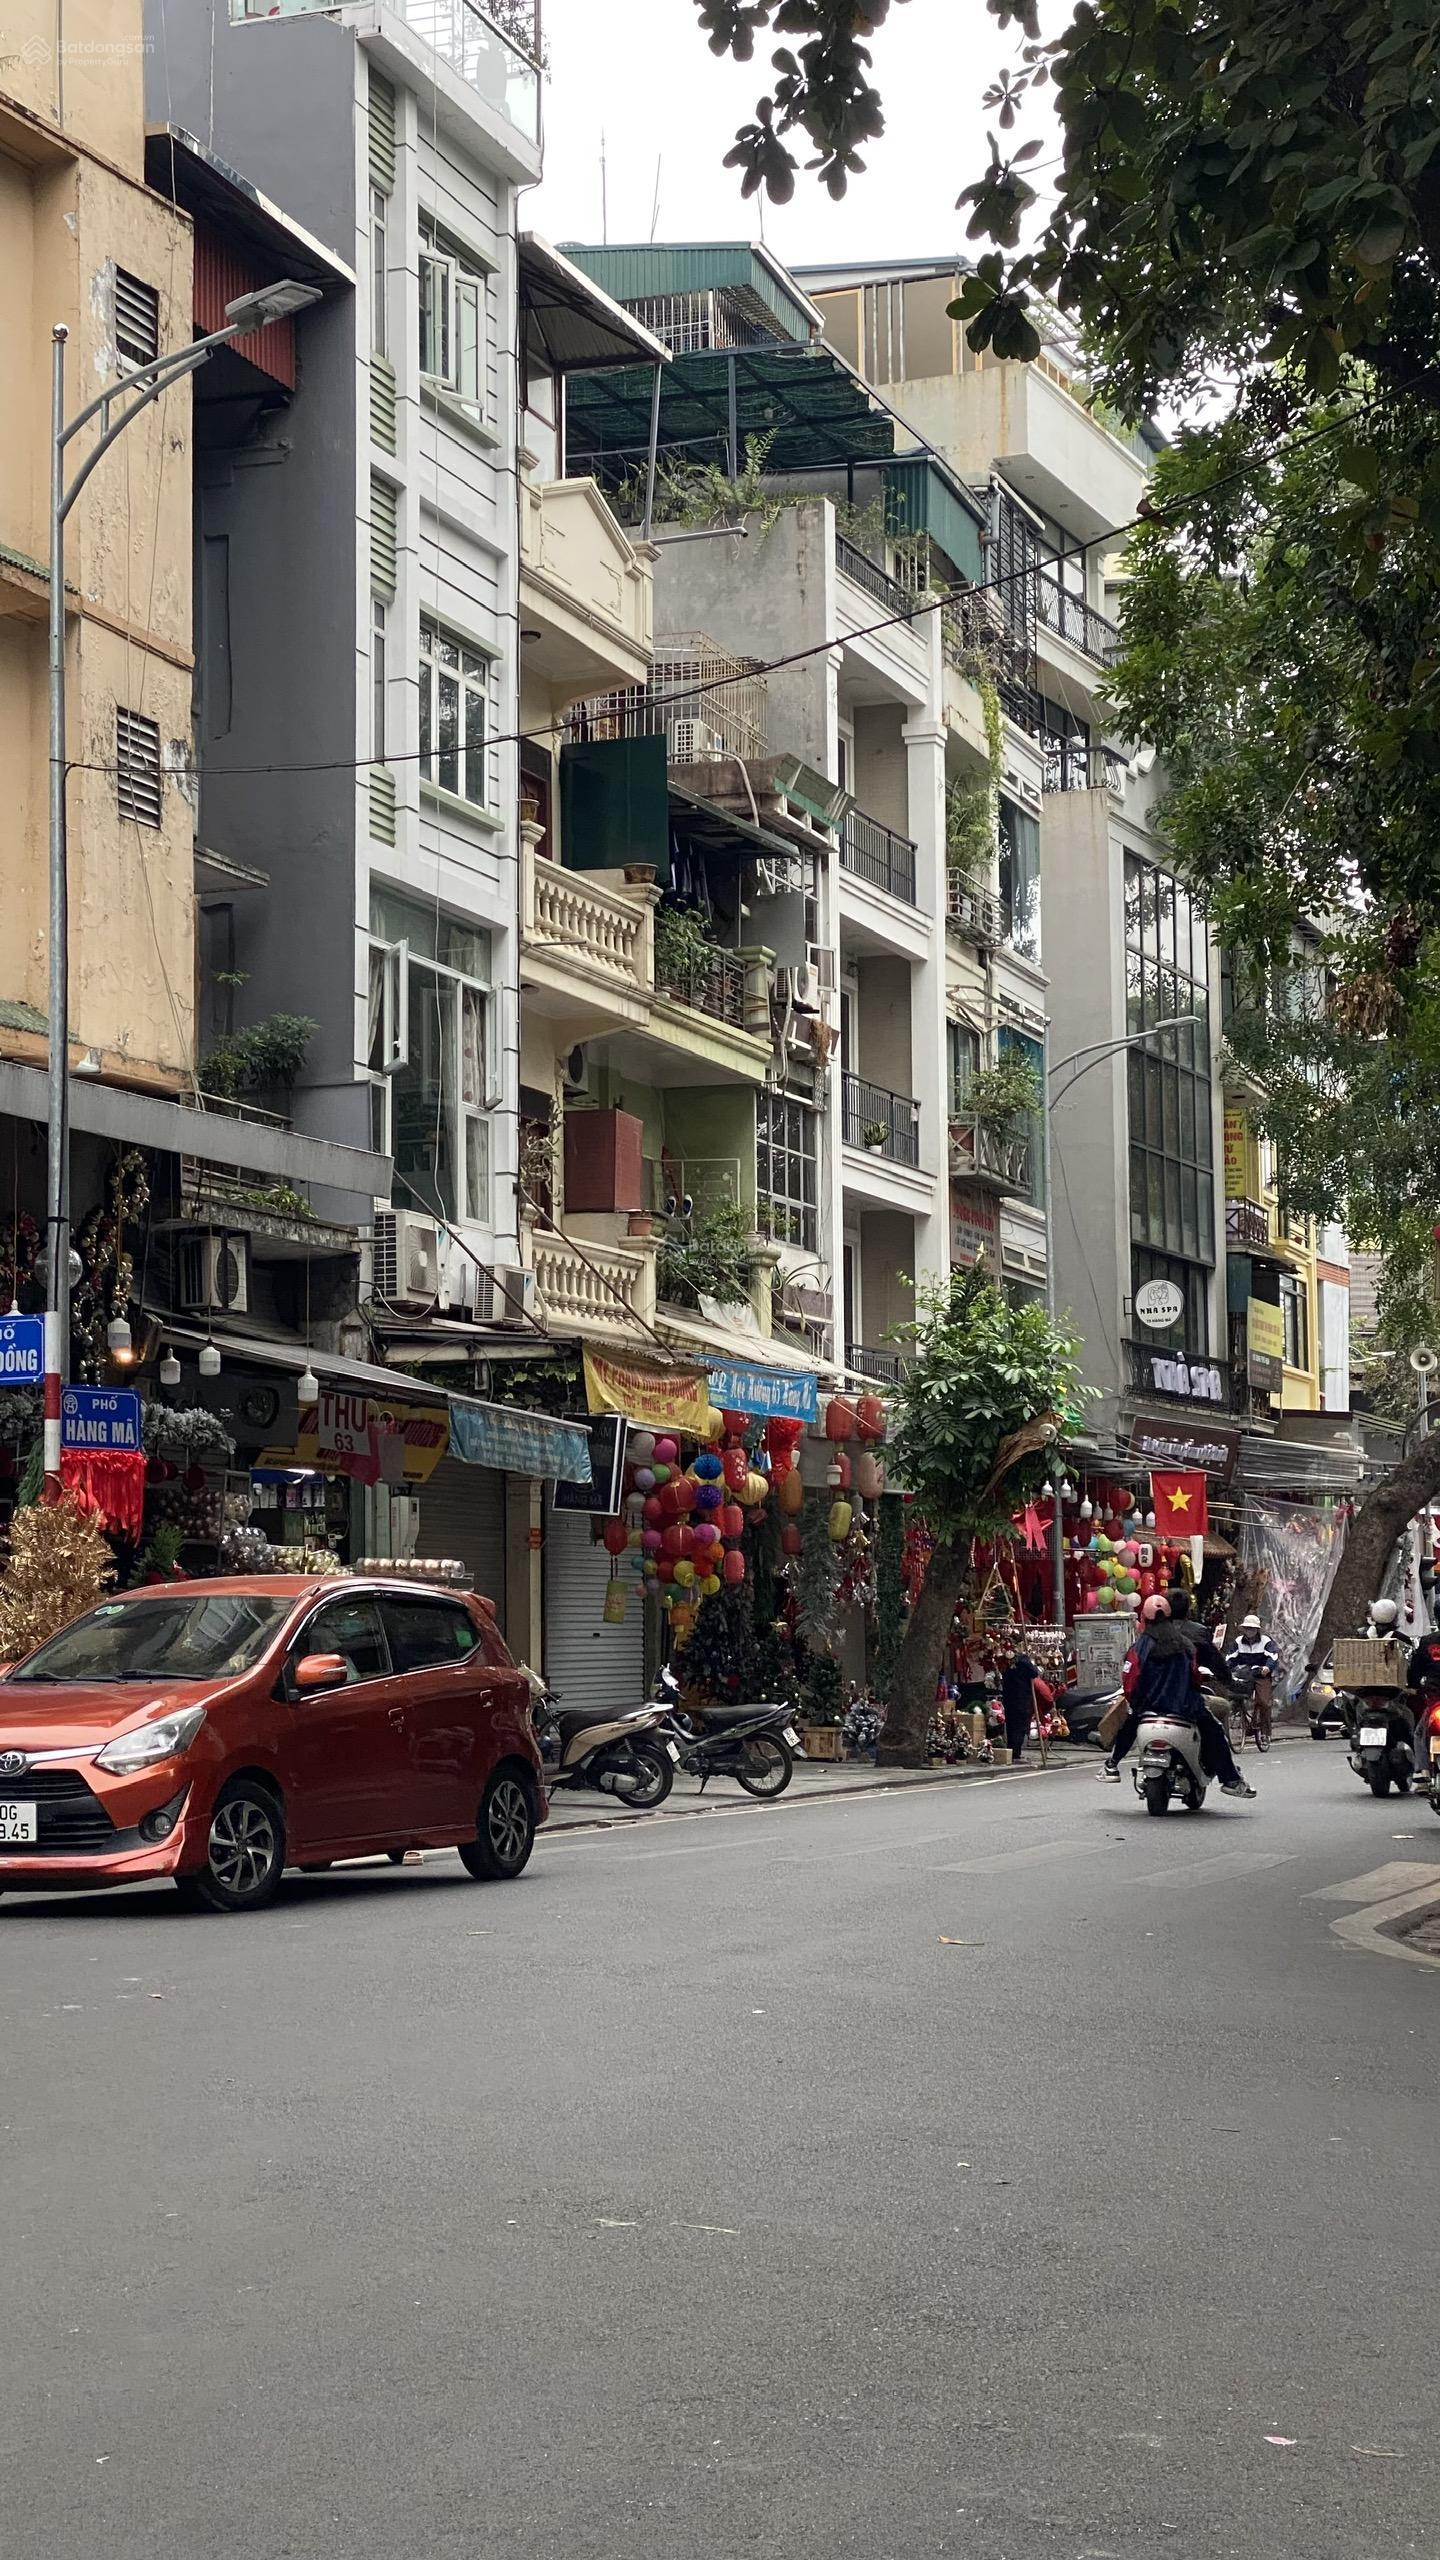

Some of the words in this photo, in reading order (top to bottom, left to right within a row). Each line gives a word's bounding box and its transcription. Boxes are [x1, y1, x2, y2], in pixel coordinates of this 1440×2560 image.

[0, 1323, 16, 1341] Ố
[92, 1395, 118, 1411] PHỐ
[320, 1391, 368, 1433] THU
[66, 1414, 107, 1443] HÀNG
[112, 1419, 135, 1444] MÃ
[334, 1432, 354, 1451] 63
